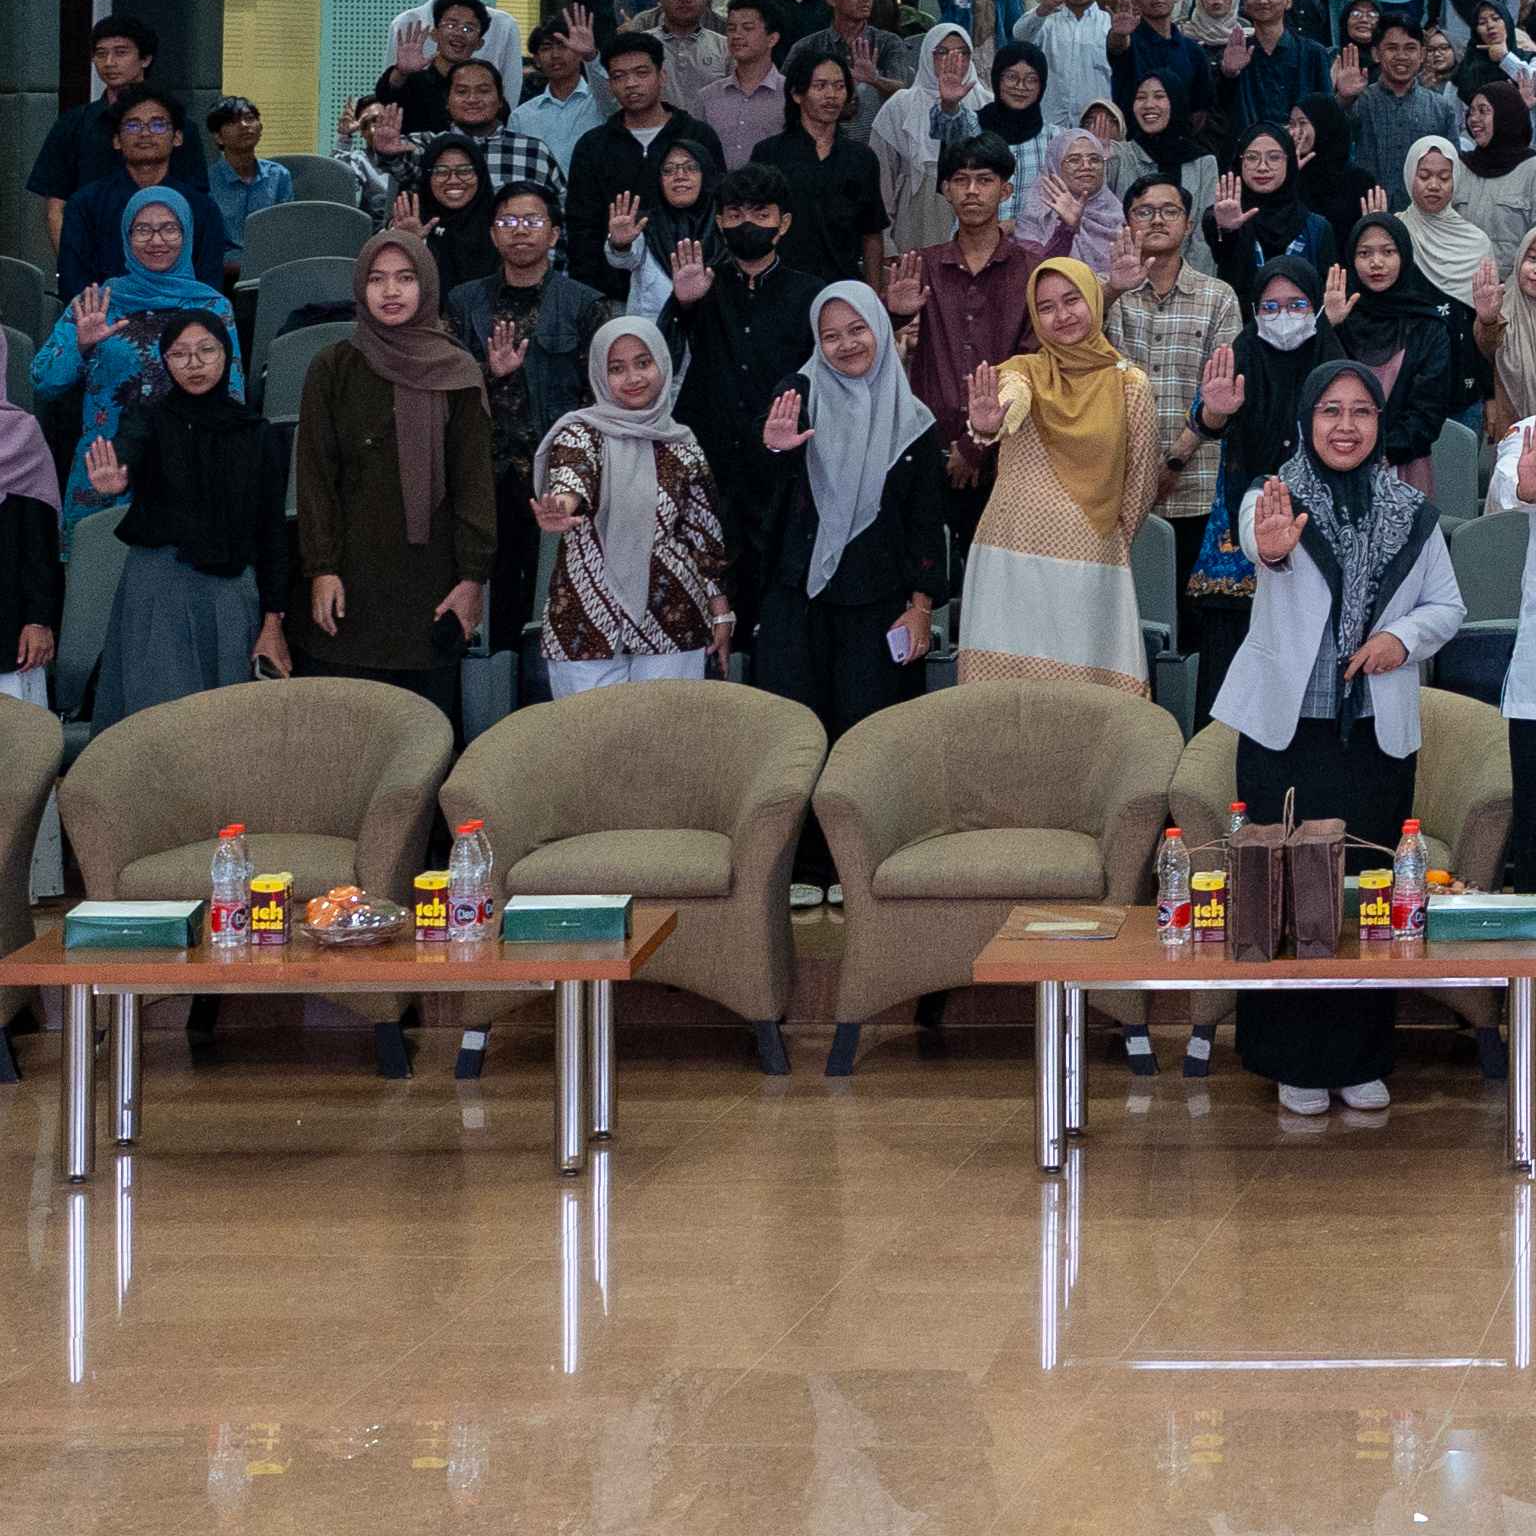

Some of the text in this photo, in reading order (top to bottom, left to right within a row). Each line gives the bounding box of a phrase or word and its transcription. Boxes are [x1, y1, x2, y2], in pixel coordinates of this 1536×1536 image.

[252, 901, 283, 920] teh
[416, 897, 446, 916] teh
[1194, 898, 1224, 917] teh
[1360, 896, 1390, 916] teh
